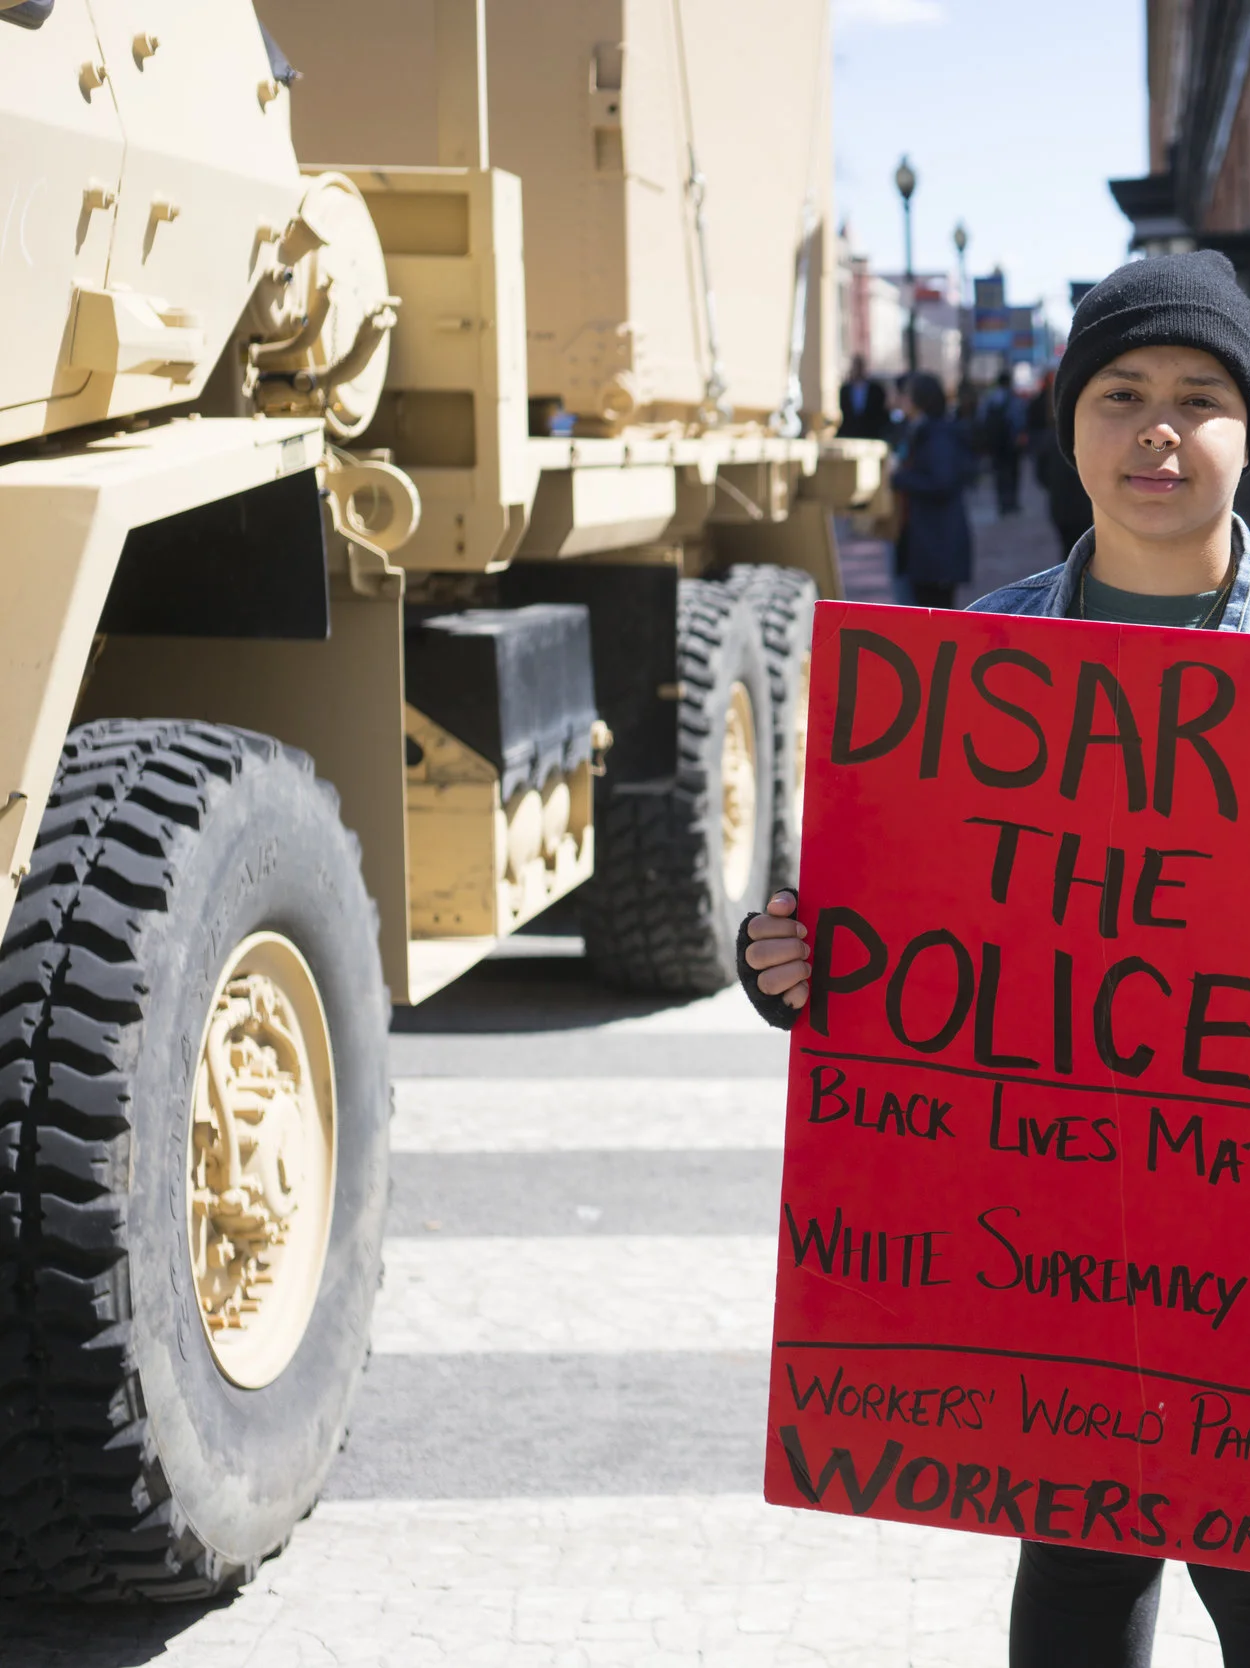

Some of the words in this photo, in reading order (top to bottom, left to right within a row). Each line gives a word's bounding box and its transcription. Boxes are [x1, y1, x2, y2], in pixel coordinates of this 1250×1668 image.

[963, 816, 1213, 940] THE
[808, 1065, 957, 1141] BLACK
[989, 1081, 1118, 1164] LIVES
[784, 1203, 952, 1288] WHITE
[976, 1206, 1248, 1330] SUPREMACY
[785, 1363, 995, 1430] WORKERS'
[1020, 1373, 1164, 1446] WORLD
